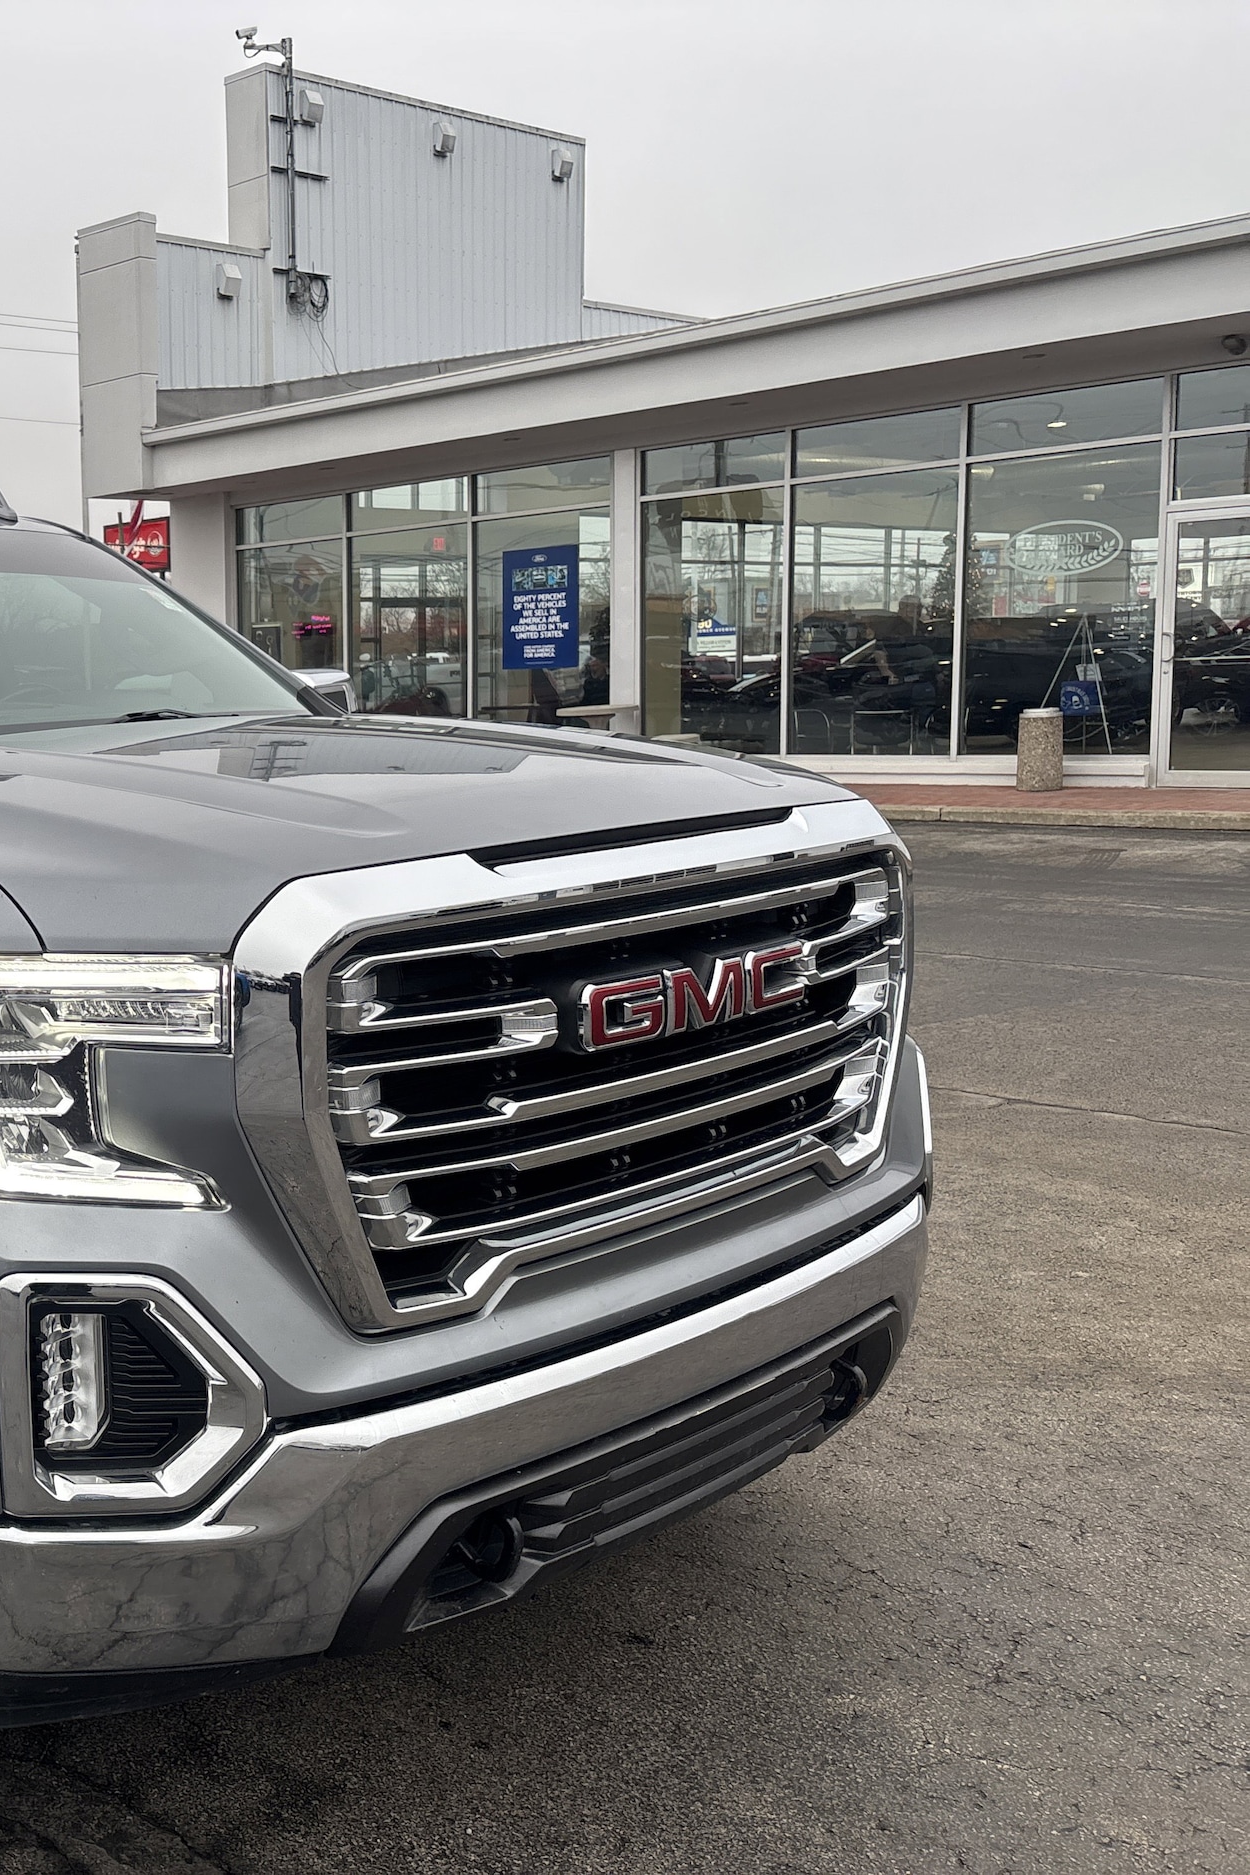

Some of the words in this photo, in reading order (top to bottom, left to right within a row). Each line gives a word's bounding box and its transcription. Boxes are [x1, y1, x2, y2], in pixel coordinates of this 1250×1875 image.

[1023, 530, 1103, 548] PSIDENT'S
[514, 594, 537, 603] EIGHTY
[538, 592, 566, 601] PERCENT
[513, 603, 523, 611] OF
[524, 602, 536, 610] THE
[537, 600, 566, 609] VEHICLES
[519, 616, 547, 625] AMERICA
[548, 615, 561, 623] ARE
[510, 623, 547, 633] ASSEMBLED
[557, 622, 569, 630] THE
[515, 631, 539, 640] UNITED
[540, 630, 564, 639] STATES.
[579, 941, 805, 1053] GMC
